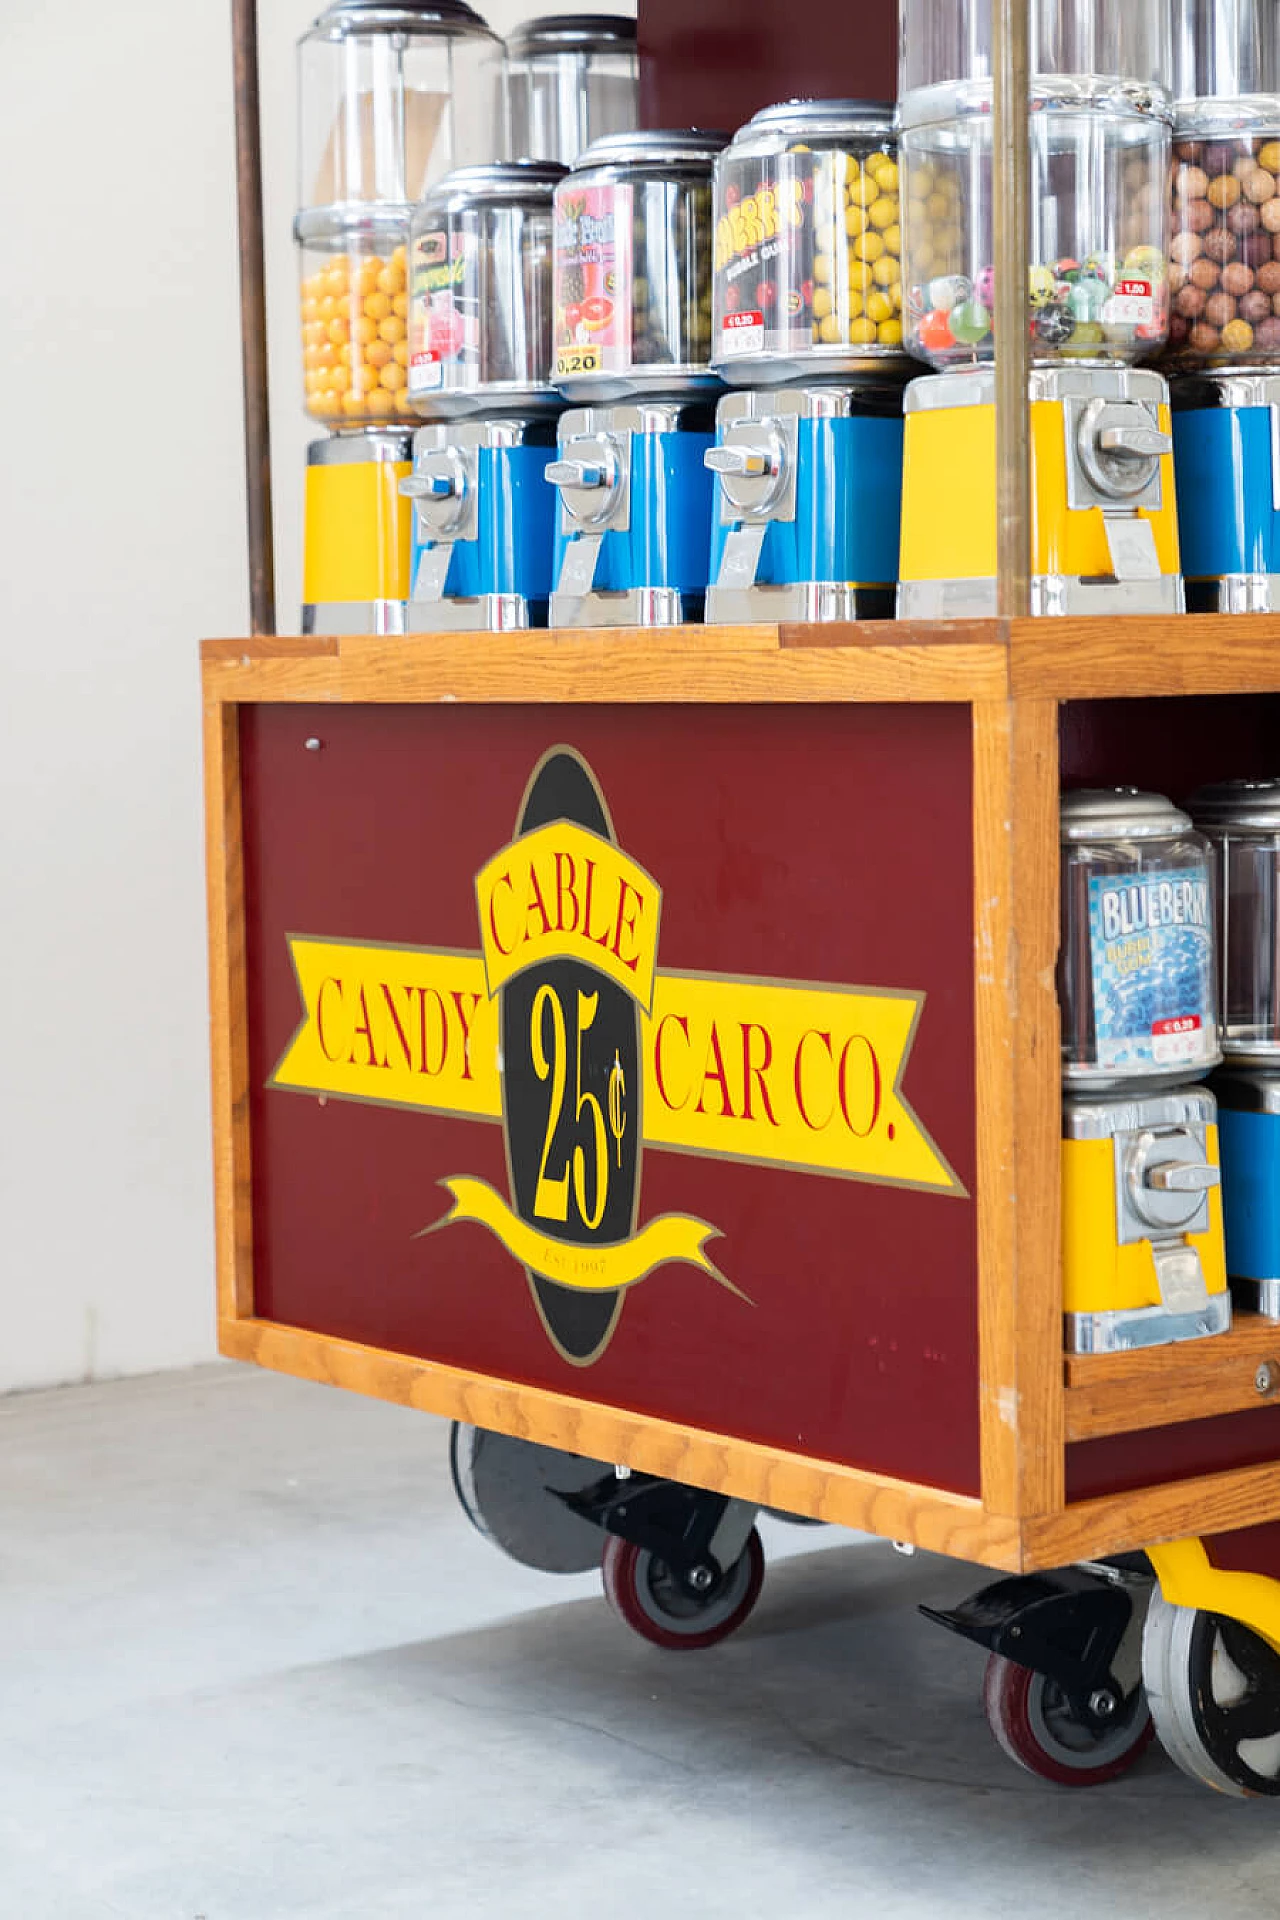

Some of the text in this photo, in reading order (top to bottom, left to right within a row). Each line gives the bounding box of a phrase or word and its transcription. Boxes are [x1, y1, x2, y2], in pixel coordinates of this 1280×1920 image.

[489, 852, 644, 972] CABLE
[316, 976, 896, 1142] CANDY CAR CO.
